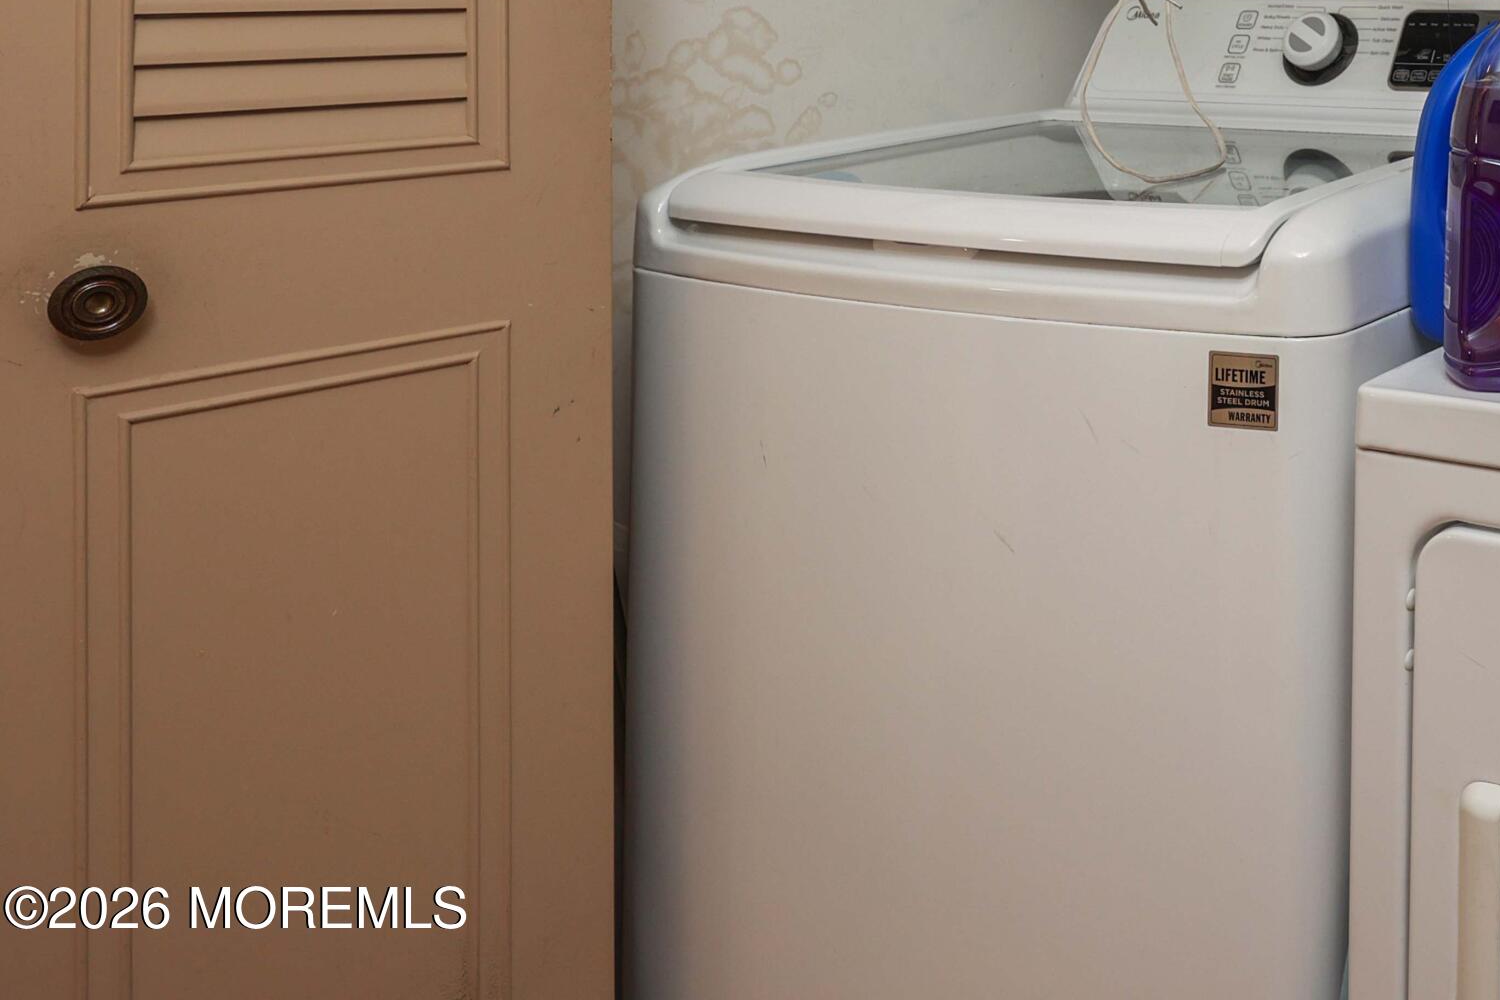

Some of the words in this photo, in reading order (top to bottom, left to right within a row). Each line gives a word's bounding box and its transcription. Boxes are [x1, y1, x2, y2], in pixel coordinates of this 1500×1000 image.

[1215, 367, 1266, 385] LIFETIME
[1220, 388, 1265, 398] STAINLESS
[1217, 396, 1243, 406] STEEL
[1244, 398, 1270, 407] DRUM
[1227, 410, 1271, 424] WARRANTY
